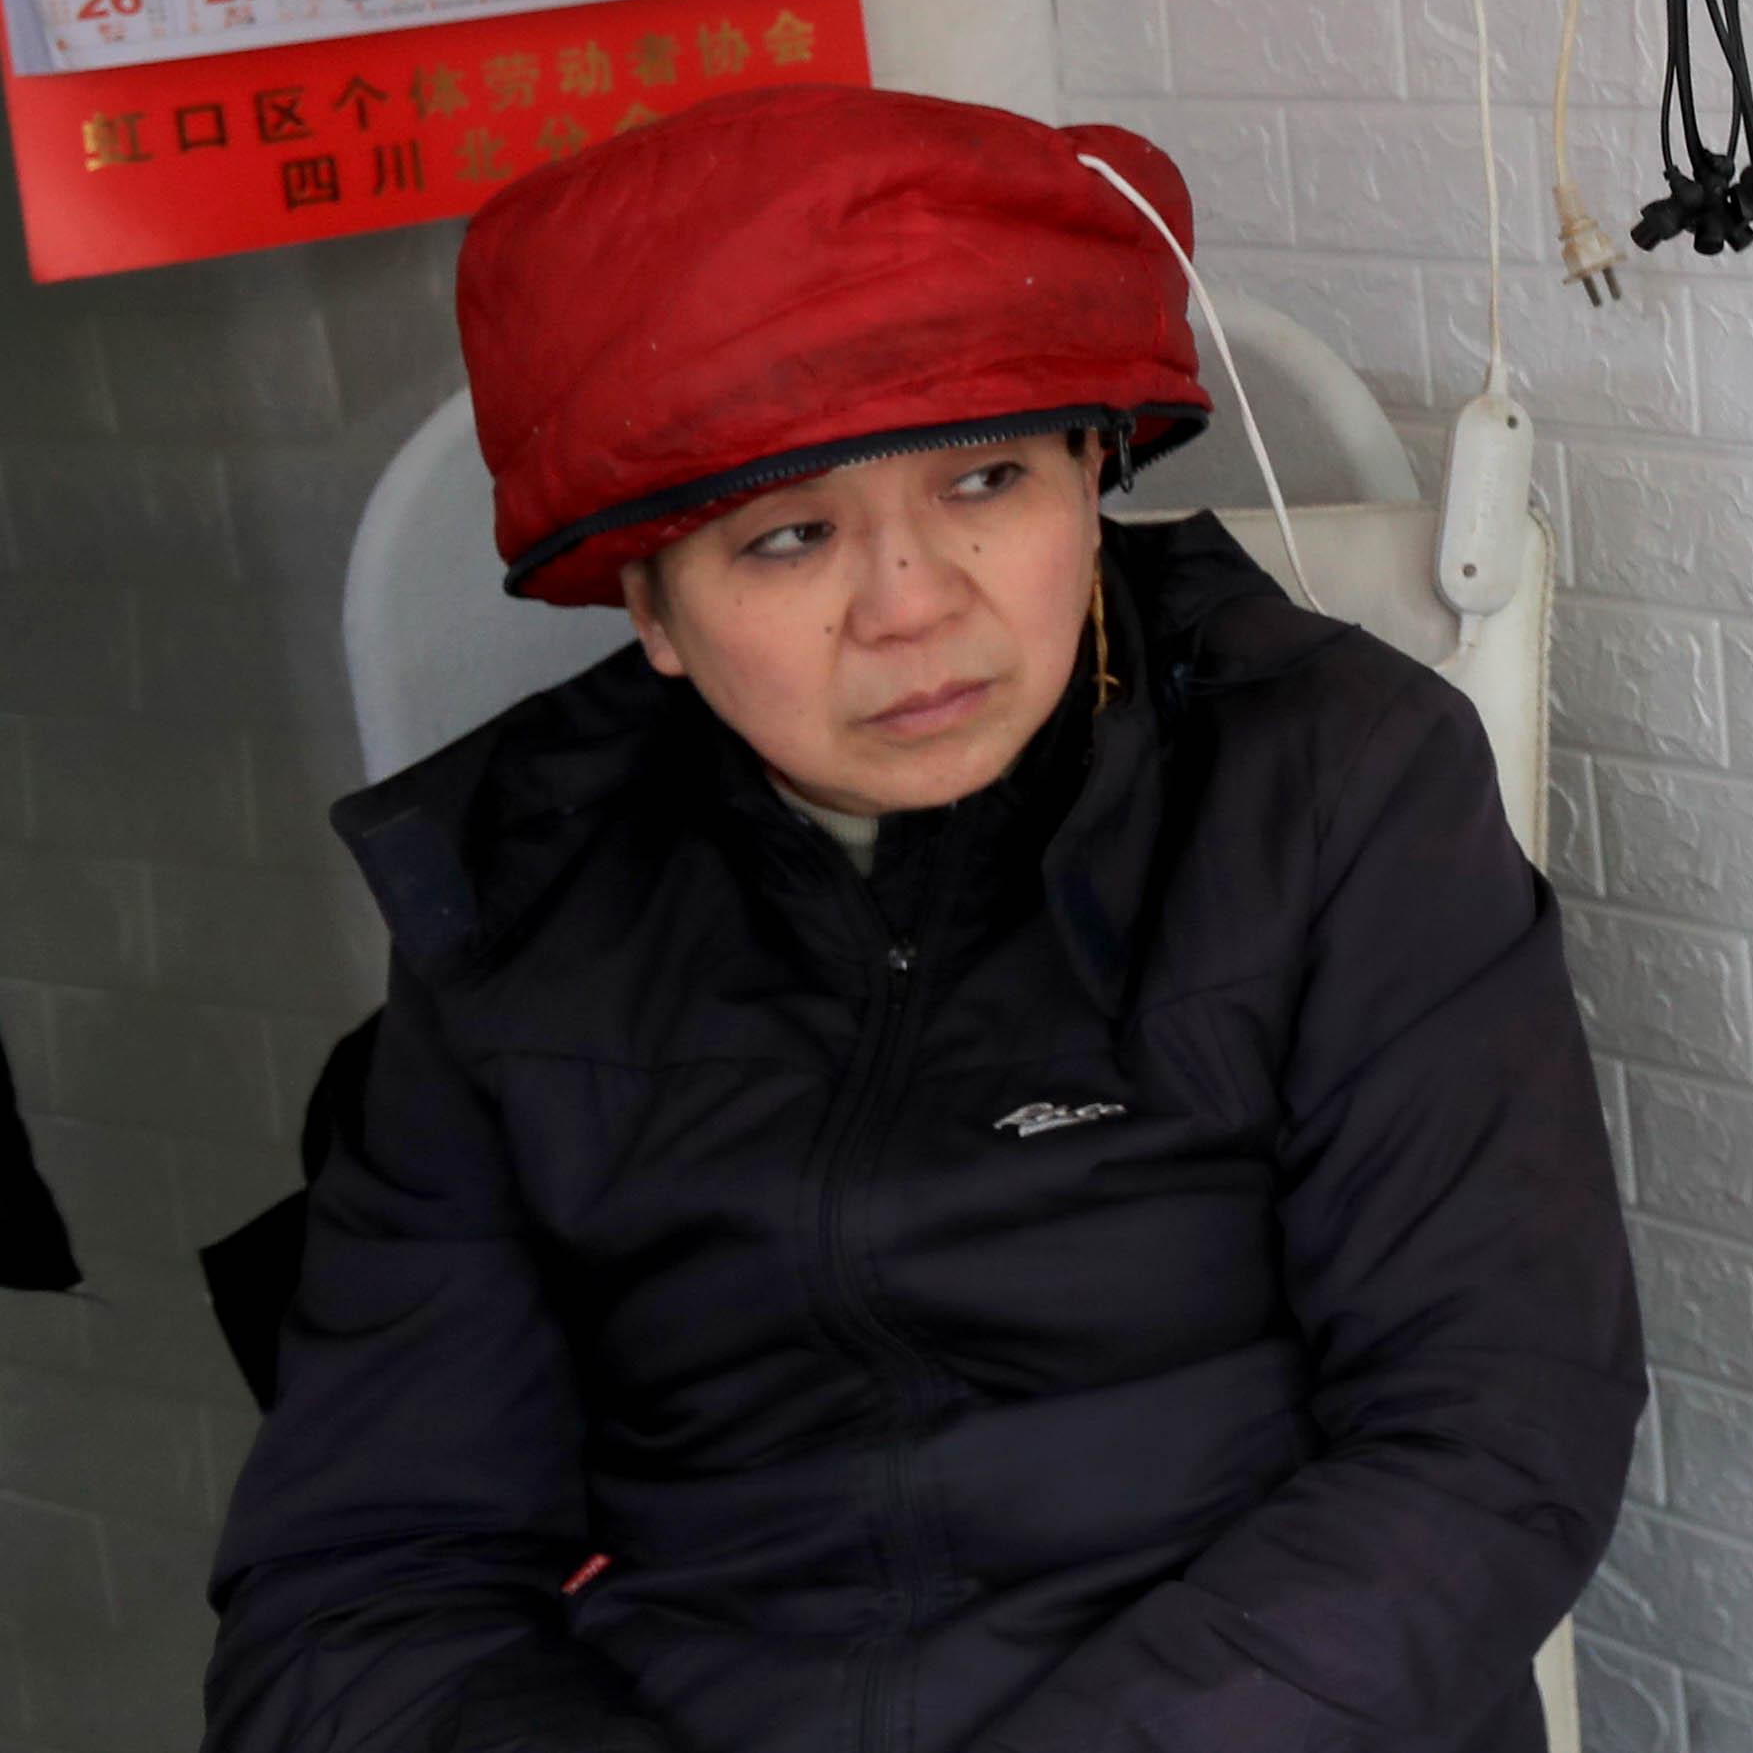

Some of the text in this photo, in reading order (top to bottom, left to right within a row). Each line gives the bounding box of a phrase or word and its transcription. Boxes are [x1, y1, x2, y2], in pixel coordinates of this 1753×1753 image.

[83, 9, 817, 173] 虹口区个体劳动者协会
